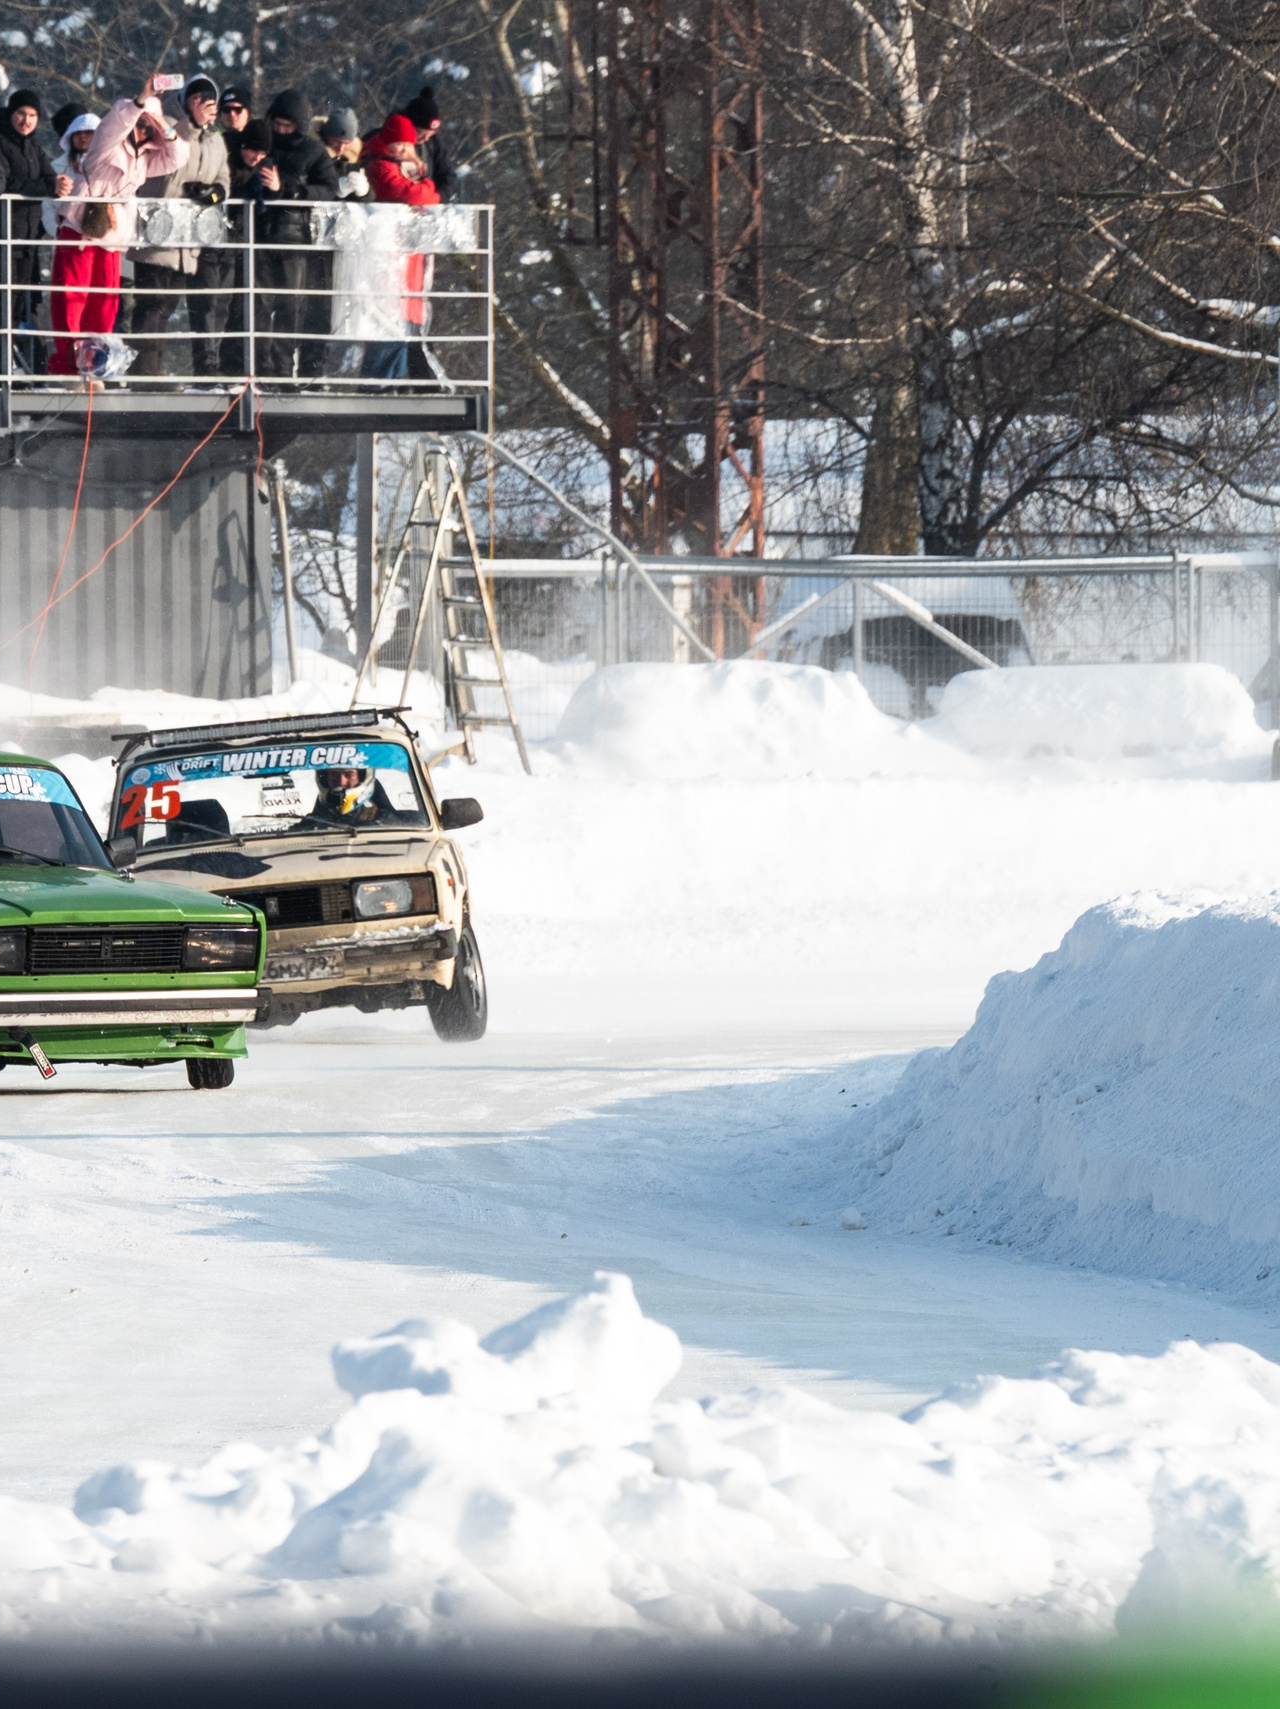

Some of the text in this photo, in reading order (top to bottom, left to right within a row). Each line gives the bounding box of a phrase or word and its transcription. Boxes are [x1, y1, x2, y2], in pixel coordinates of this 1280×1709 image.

[180, 758, 219, 771] DRIFT
[221, 746, 357, 772] WINTER CUP
[121, 780, 181, 830] 25
